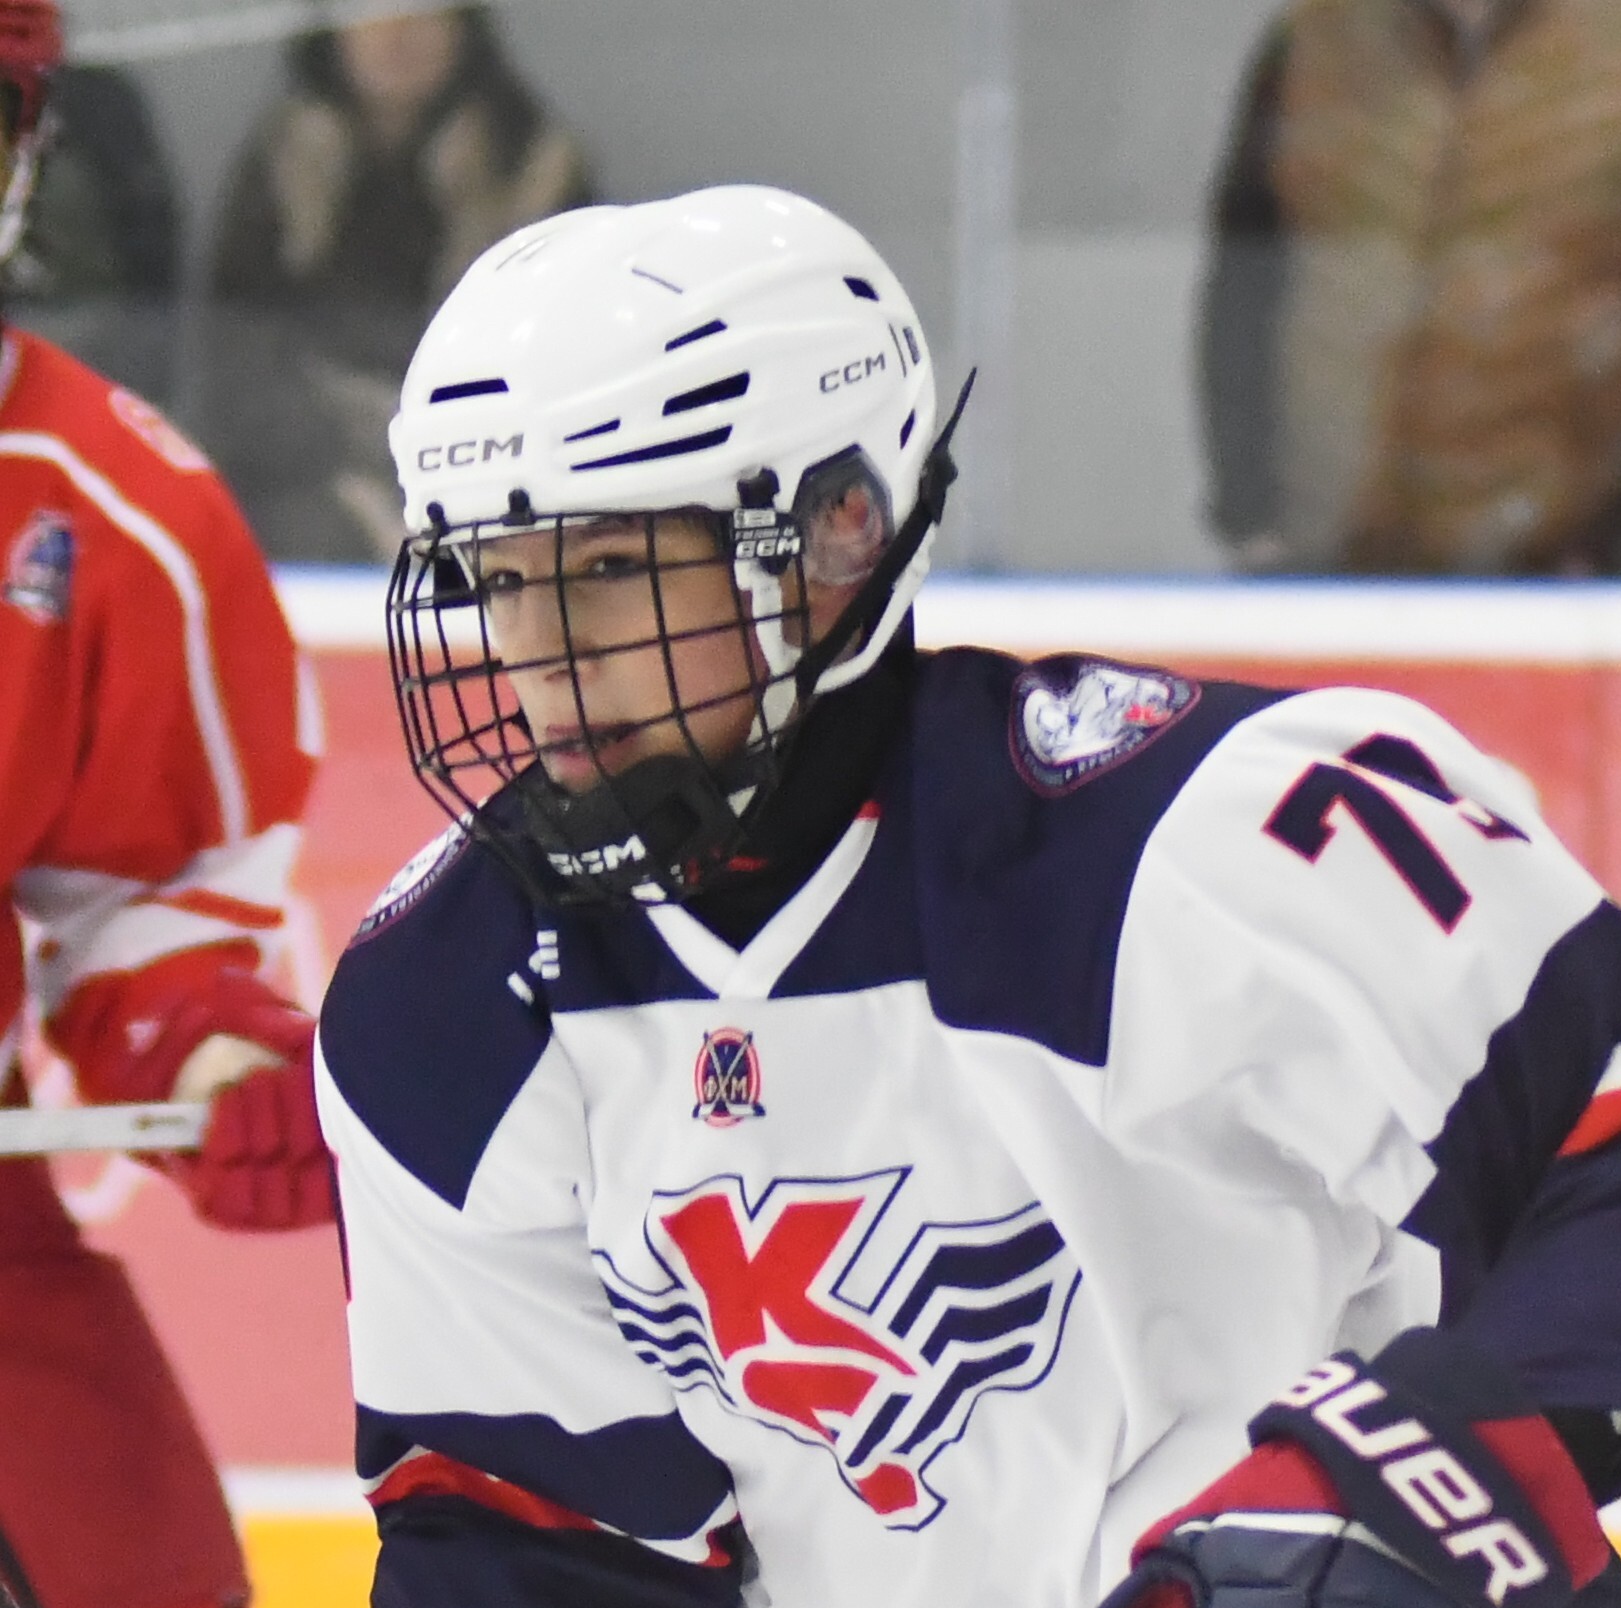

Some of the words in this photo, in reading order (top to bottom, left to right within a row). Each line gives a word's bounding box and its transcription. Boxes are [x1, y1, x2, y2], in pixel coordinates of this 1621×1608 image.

[818, 351, 887, 394] CCM
[418, 433, 525, 472] CCM
[1283, 1357, 1550, 1607] AUER
